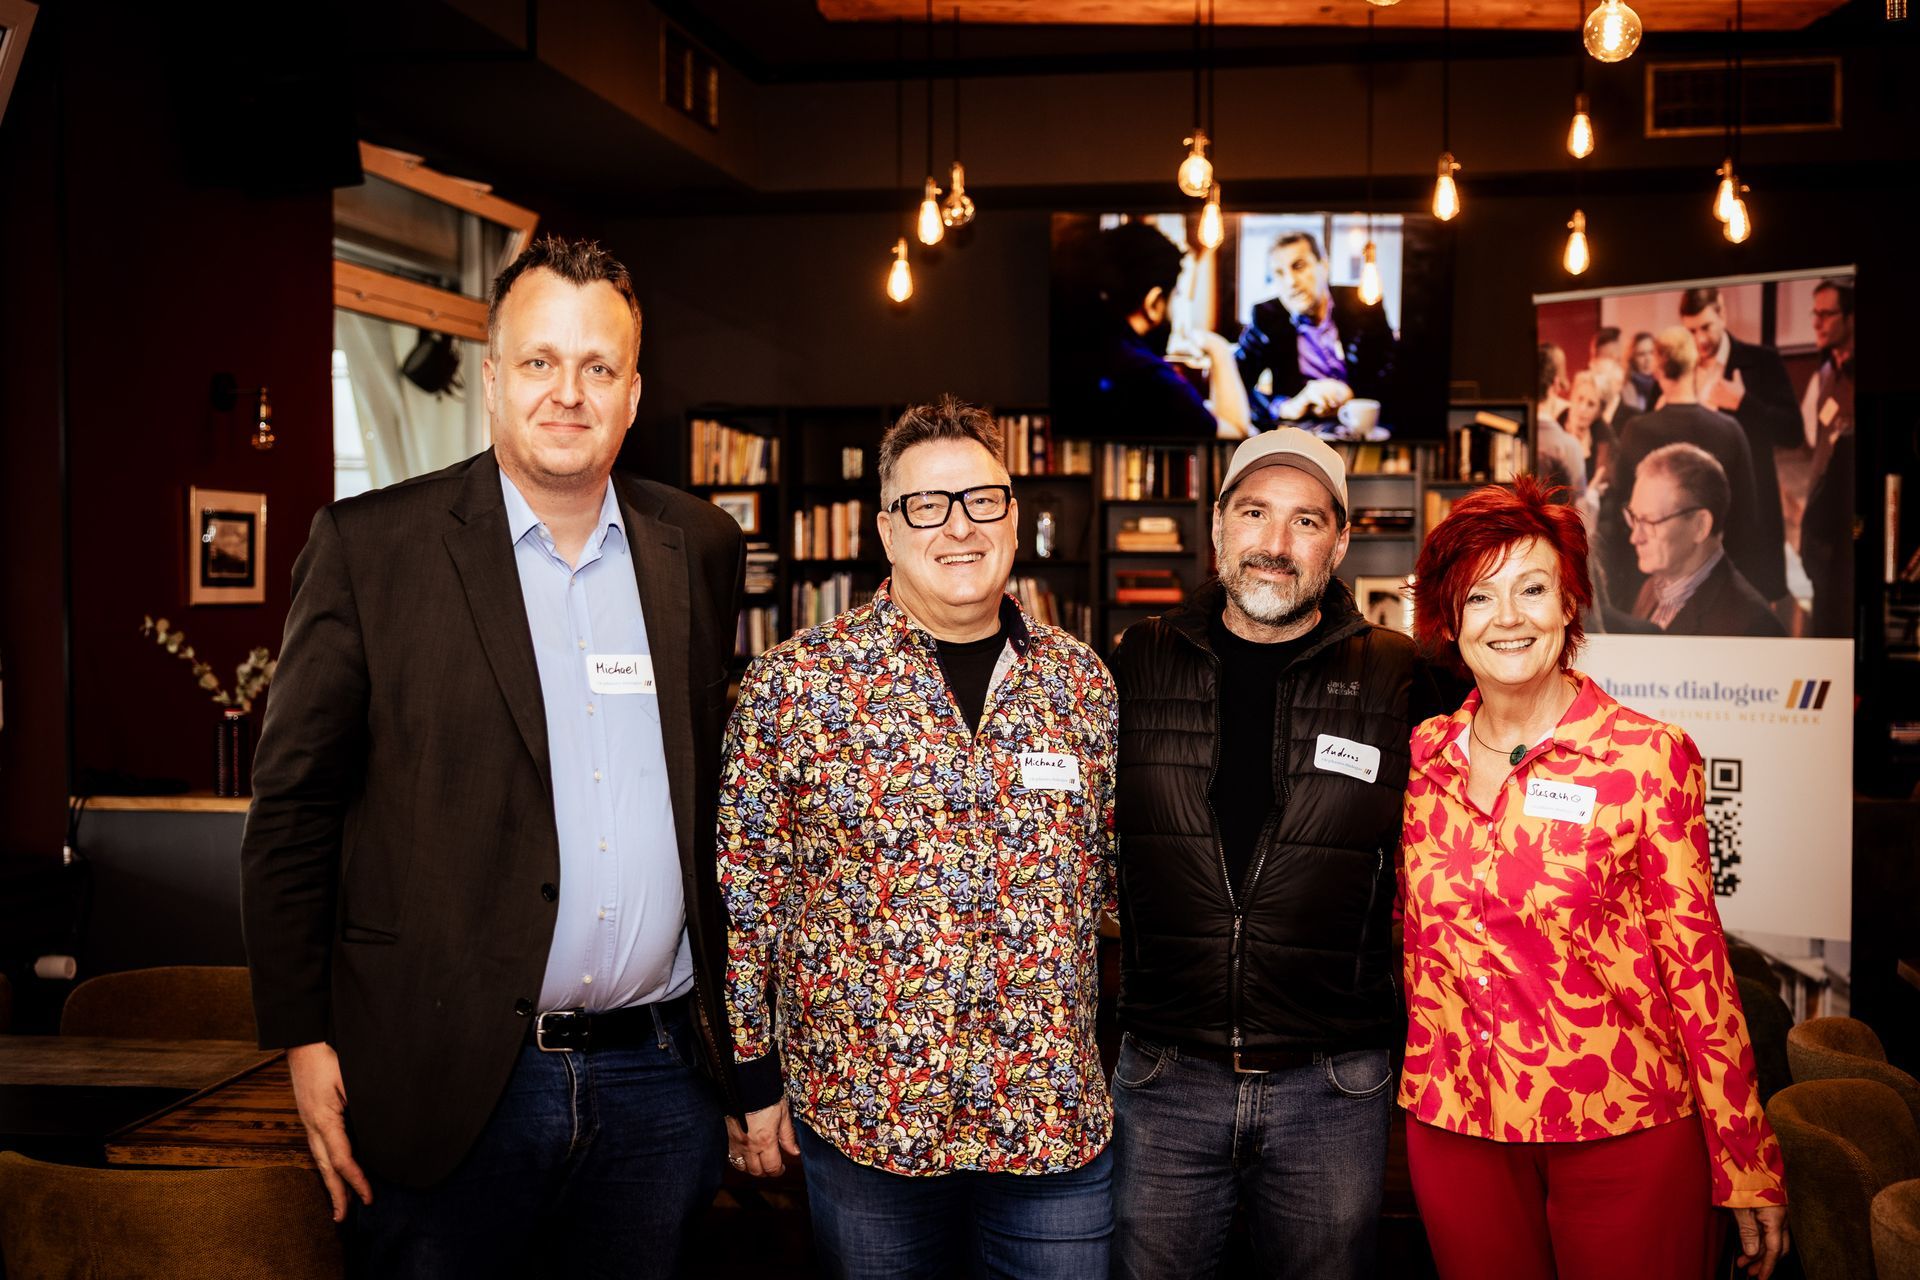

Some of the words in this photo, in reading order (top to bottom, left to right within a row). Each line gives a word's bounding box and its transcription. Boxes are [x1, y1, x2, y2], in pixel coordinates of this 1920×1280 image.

[596, 661, 638, 675] Michael
[1600, 678, 1670, 699] hants
[1675, 680, 1779, 706] dialogue
[1659, 708, 1731, 721] BUSINESS
[1739, 711, 1821, 725] NETZWERK
[1321, 743, 1359, 762] Andreas
[1025, 756, 1067, 769] Michael
